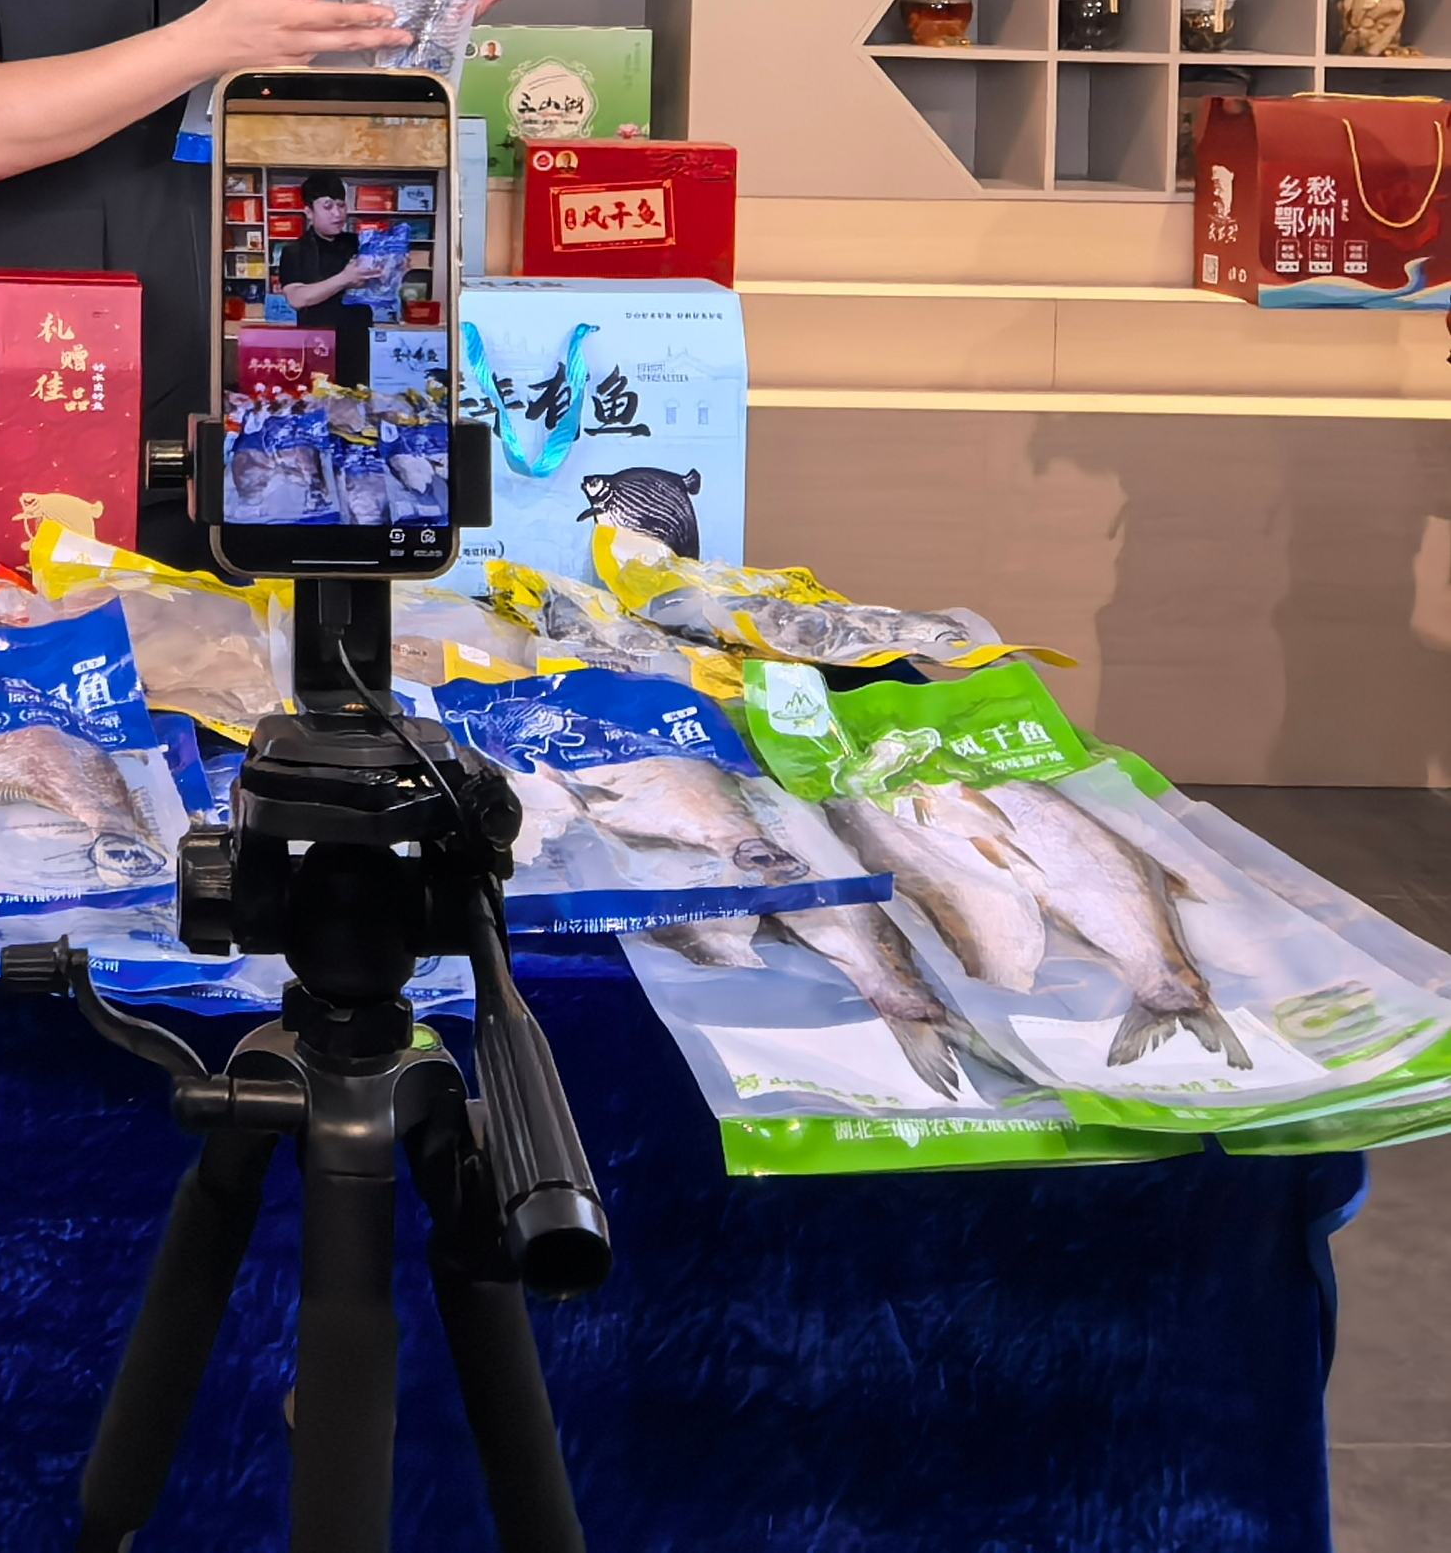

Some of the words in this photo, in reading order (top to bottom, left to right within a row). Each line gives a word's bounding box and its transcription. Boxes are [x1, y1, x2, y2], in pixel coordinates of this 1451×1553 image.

[1275, 175, 1337, 205] 乡愁
[581, 198, 662, 231] 风干鱼
[1274, 207, 1335, 237] 鄂州
[460, 361, 652, 442] 年有鱼
[949, 720, 1053, 758] 风干鱼
